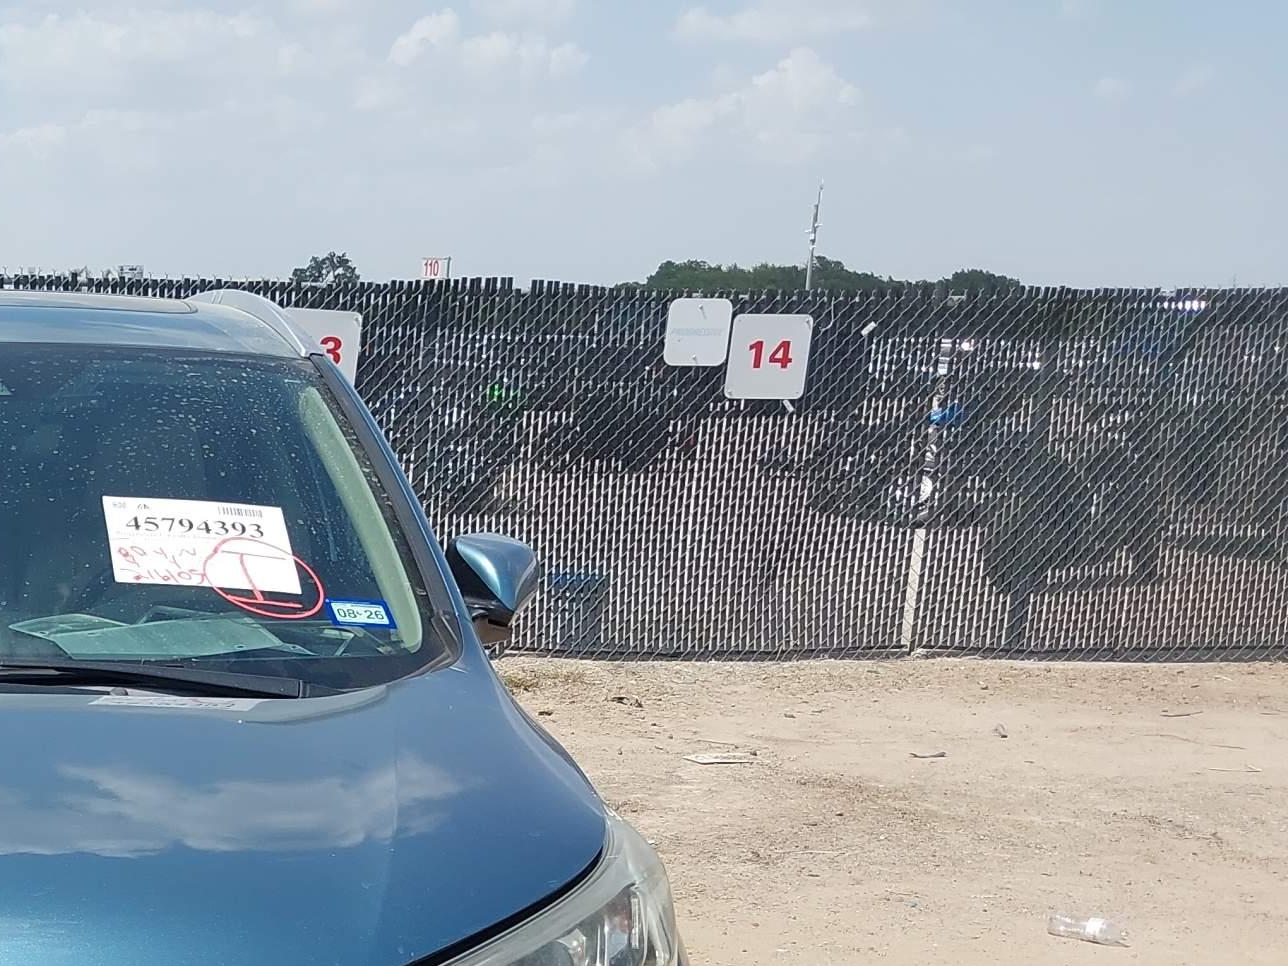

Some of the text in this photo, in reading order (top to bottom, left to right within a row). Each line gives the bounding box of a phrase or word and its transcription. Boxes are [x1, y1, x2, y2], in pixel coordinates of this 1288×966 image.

[424, 260, 440, 277] 110
[748, 340, 793, 369] 14
[125, 515, 265, 539] 45794393
